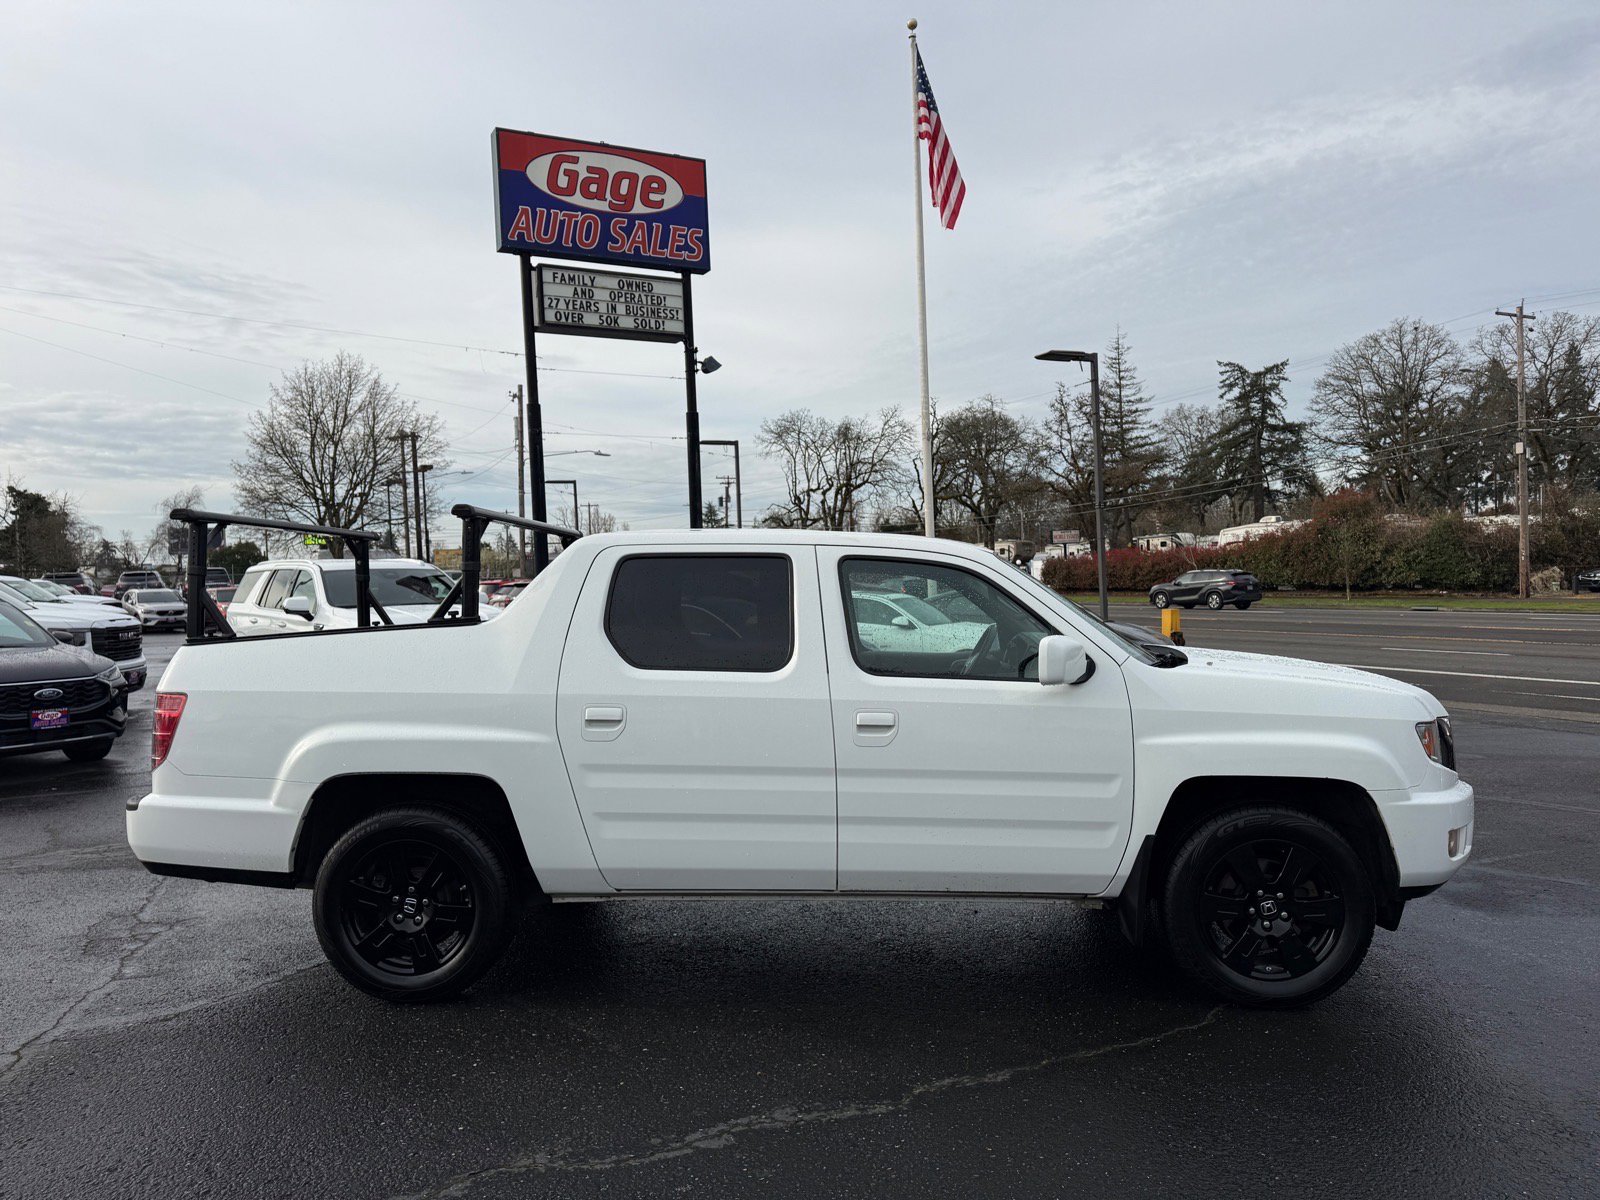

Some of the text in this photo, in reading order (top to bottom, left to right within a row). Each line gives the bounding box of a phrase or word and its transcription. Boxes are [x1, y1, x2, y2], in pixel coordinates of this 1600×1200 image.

[547, 154, 667, 212] Gage
[508, 205, 703, 261] AUTO SALES
[552, 272, 654, 293] FAMILY OWNED
[572, 287, 667, 306] AND OPERATED!
[548, 297, 679, 320] 27 YEARS IN BUSINESS!
[554, 311, 666, 330] OVER 50K SOLD!
